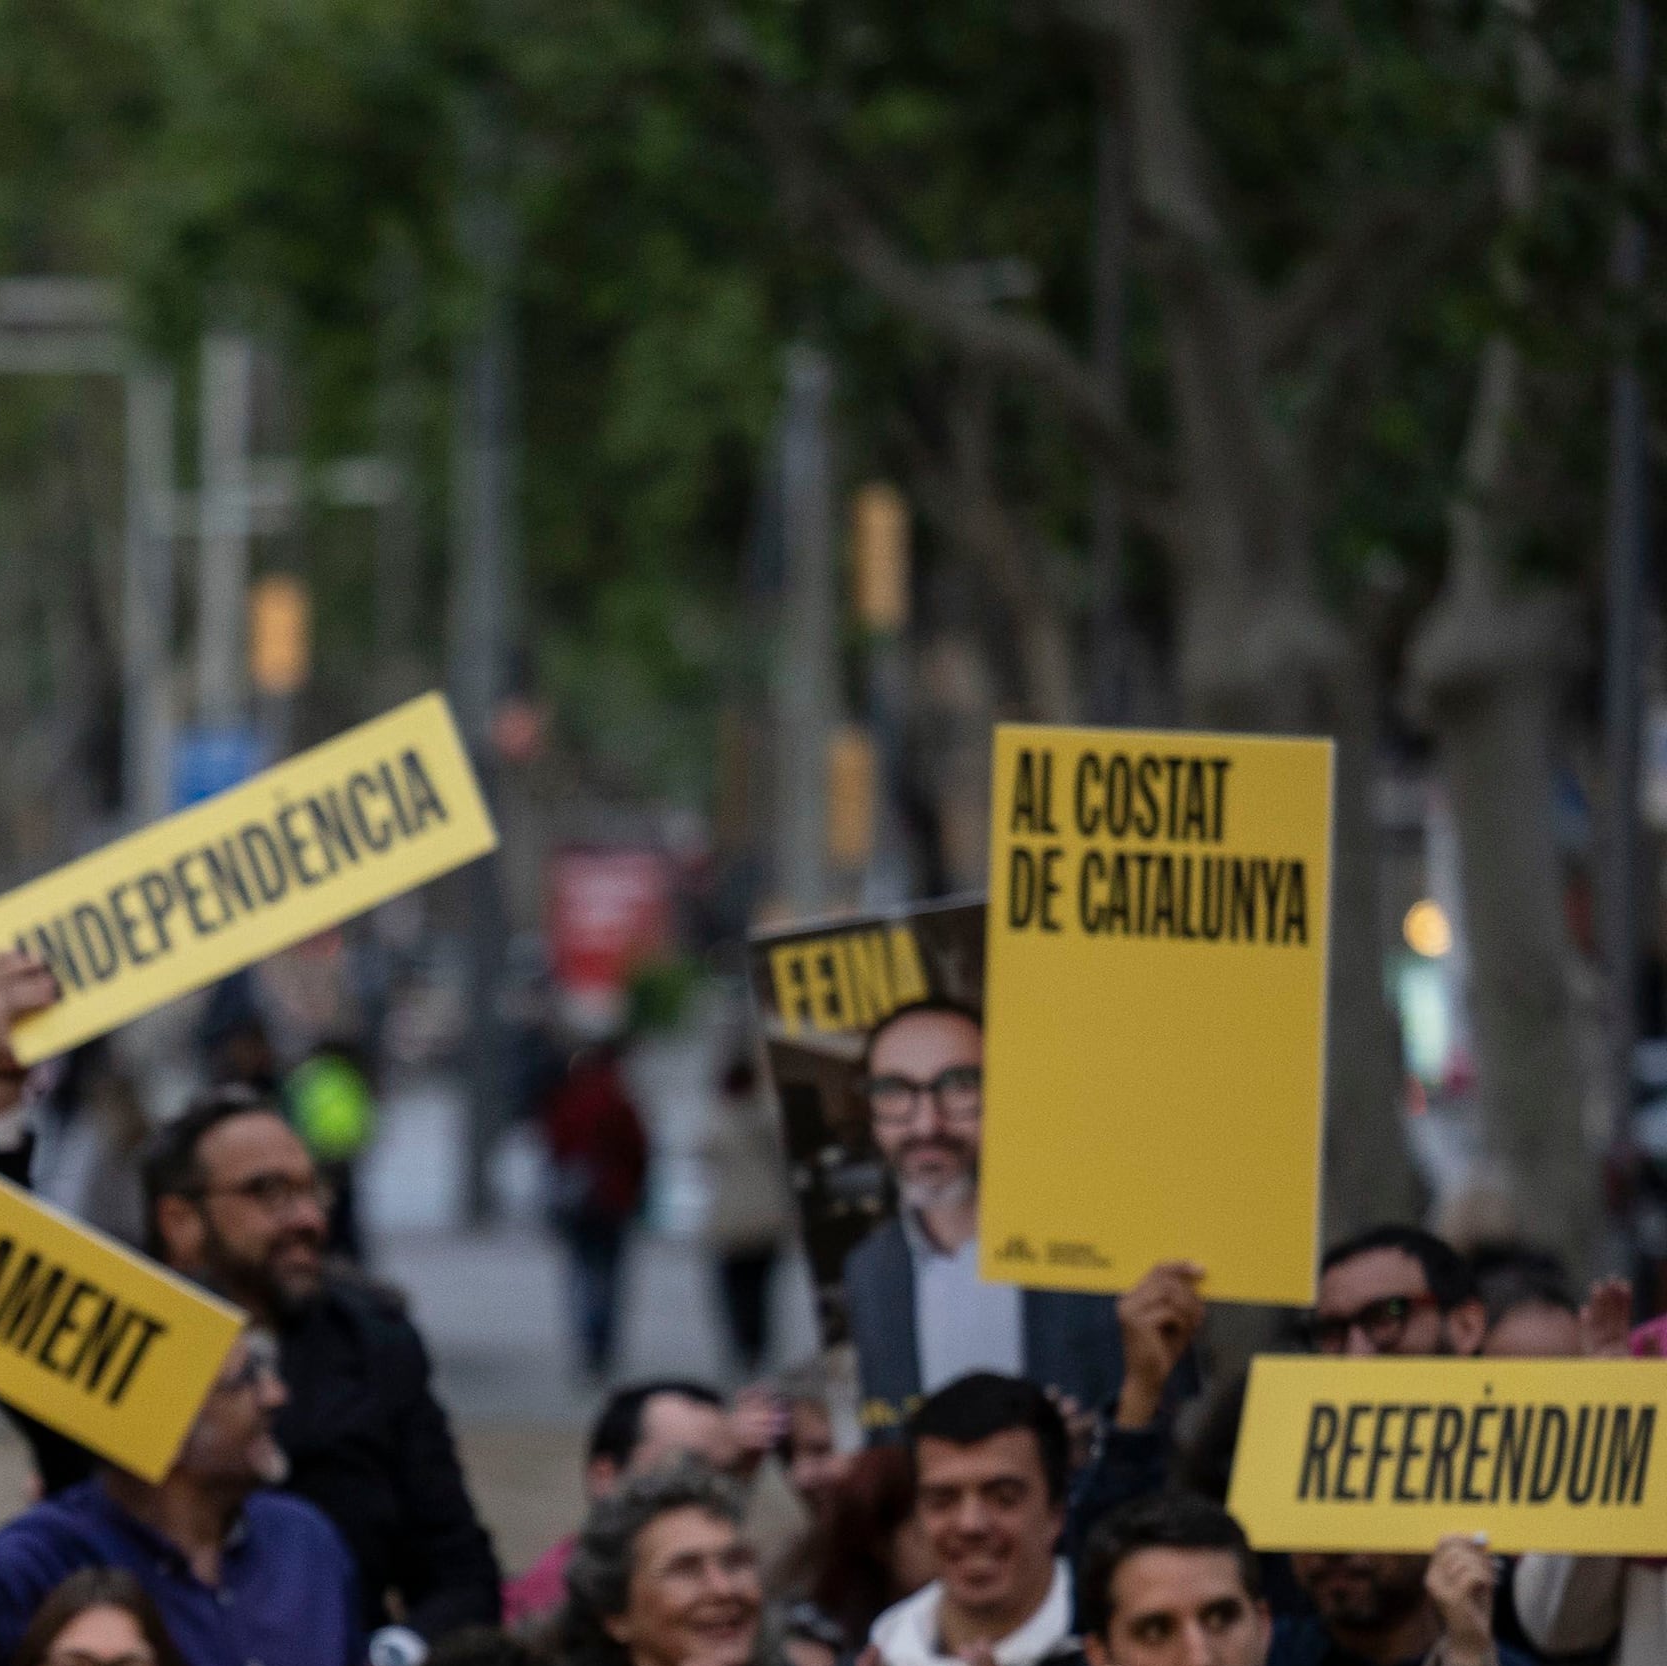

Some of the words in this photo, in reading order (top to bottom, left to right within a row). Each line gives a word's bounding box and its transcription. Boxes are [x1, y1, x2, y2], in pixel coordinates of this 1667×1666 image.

[1011, 749, 1059, 836] AL
[1074, 751, 1231, 843] COSTAT
[17, 749, 447, 990] NDEPENDÈNCIA
[1008, 846, 1063, 933] DE
[1078, 849, 1308, 946] CATALUNYA
[770, 927, 930, 1041] FEINA
[1296, 1381, 1658, 1507] REFERÈNDUM
